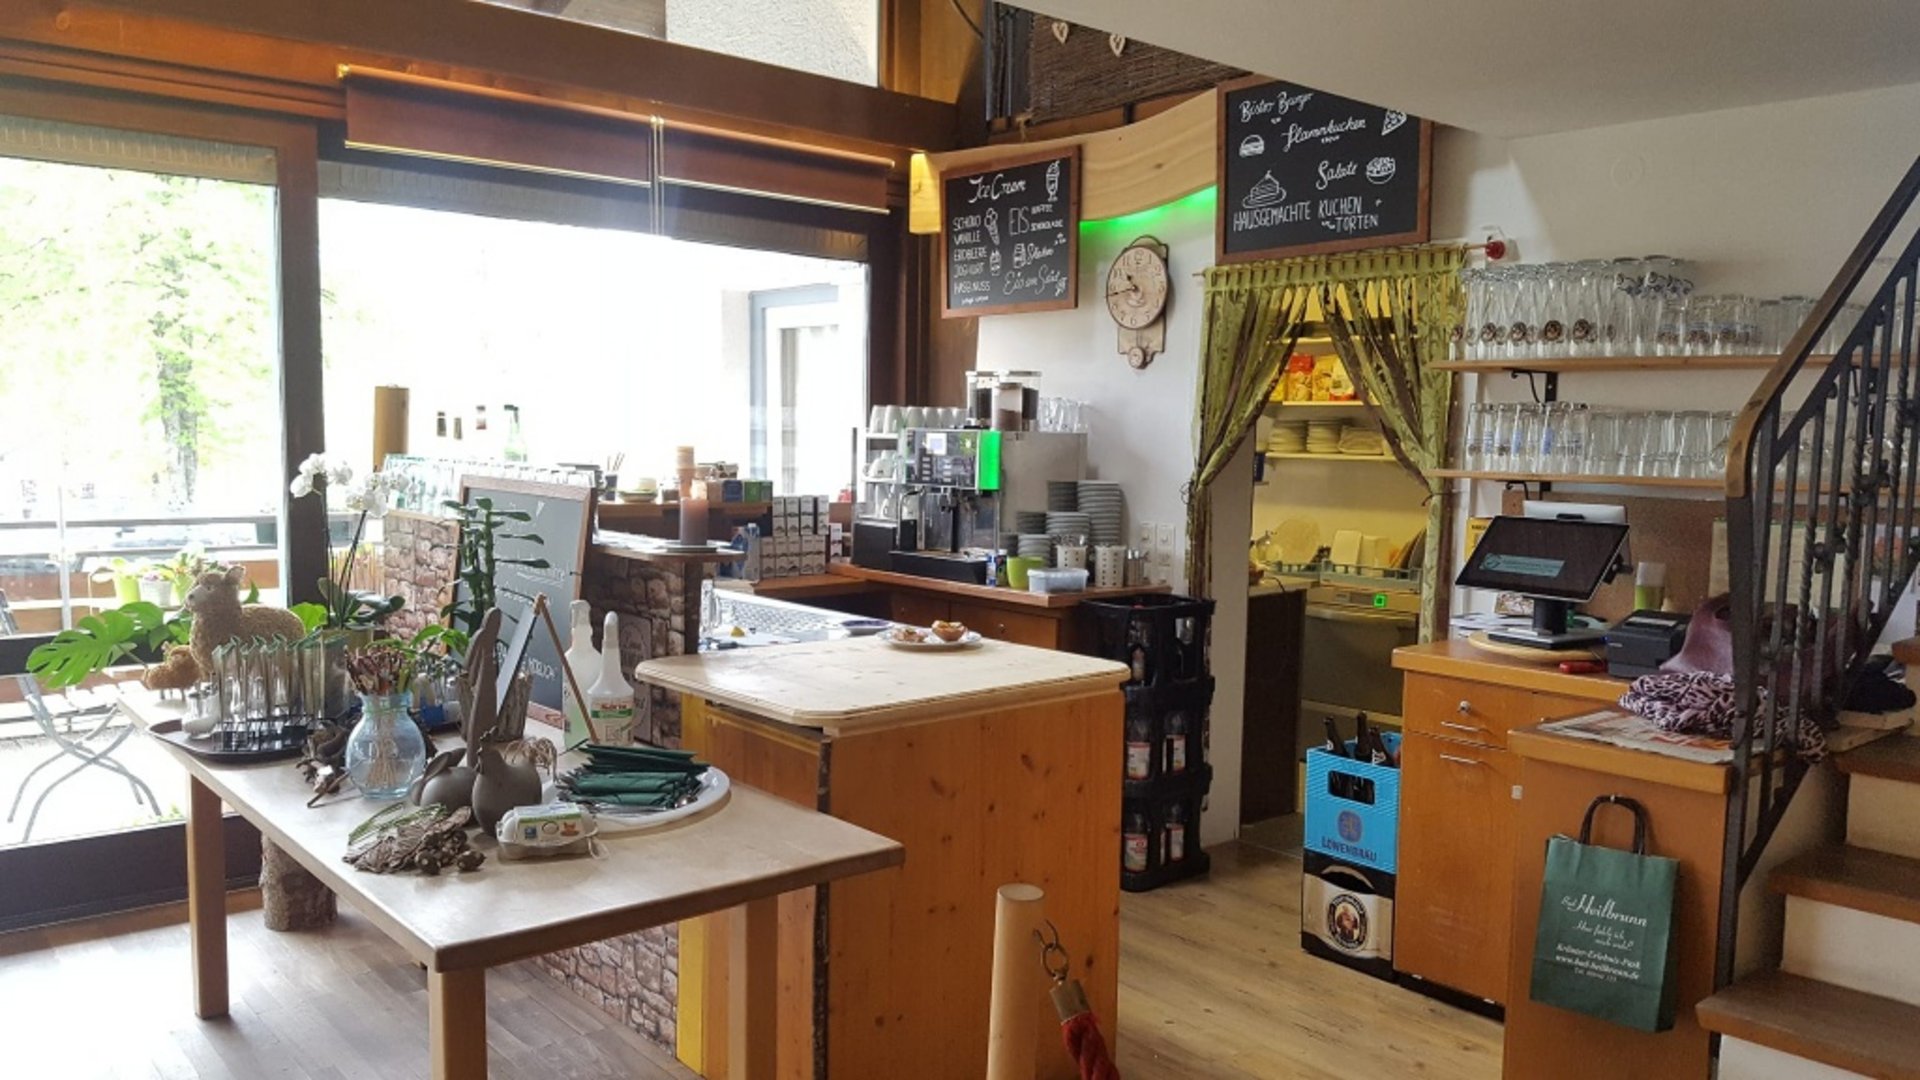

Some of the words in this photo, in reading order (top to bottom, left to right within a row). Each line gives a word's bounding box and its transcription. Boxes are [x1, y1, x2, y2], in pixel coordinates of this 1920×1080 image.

[1233, 201, 1312, 232] HAUSGEMACHTE
[1318, 196, 1362, 220] KUCHEN
[1335, 214, 1379, 233] TORTEN
[1567, 894, 1647, 927] Heilbrunn
